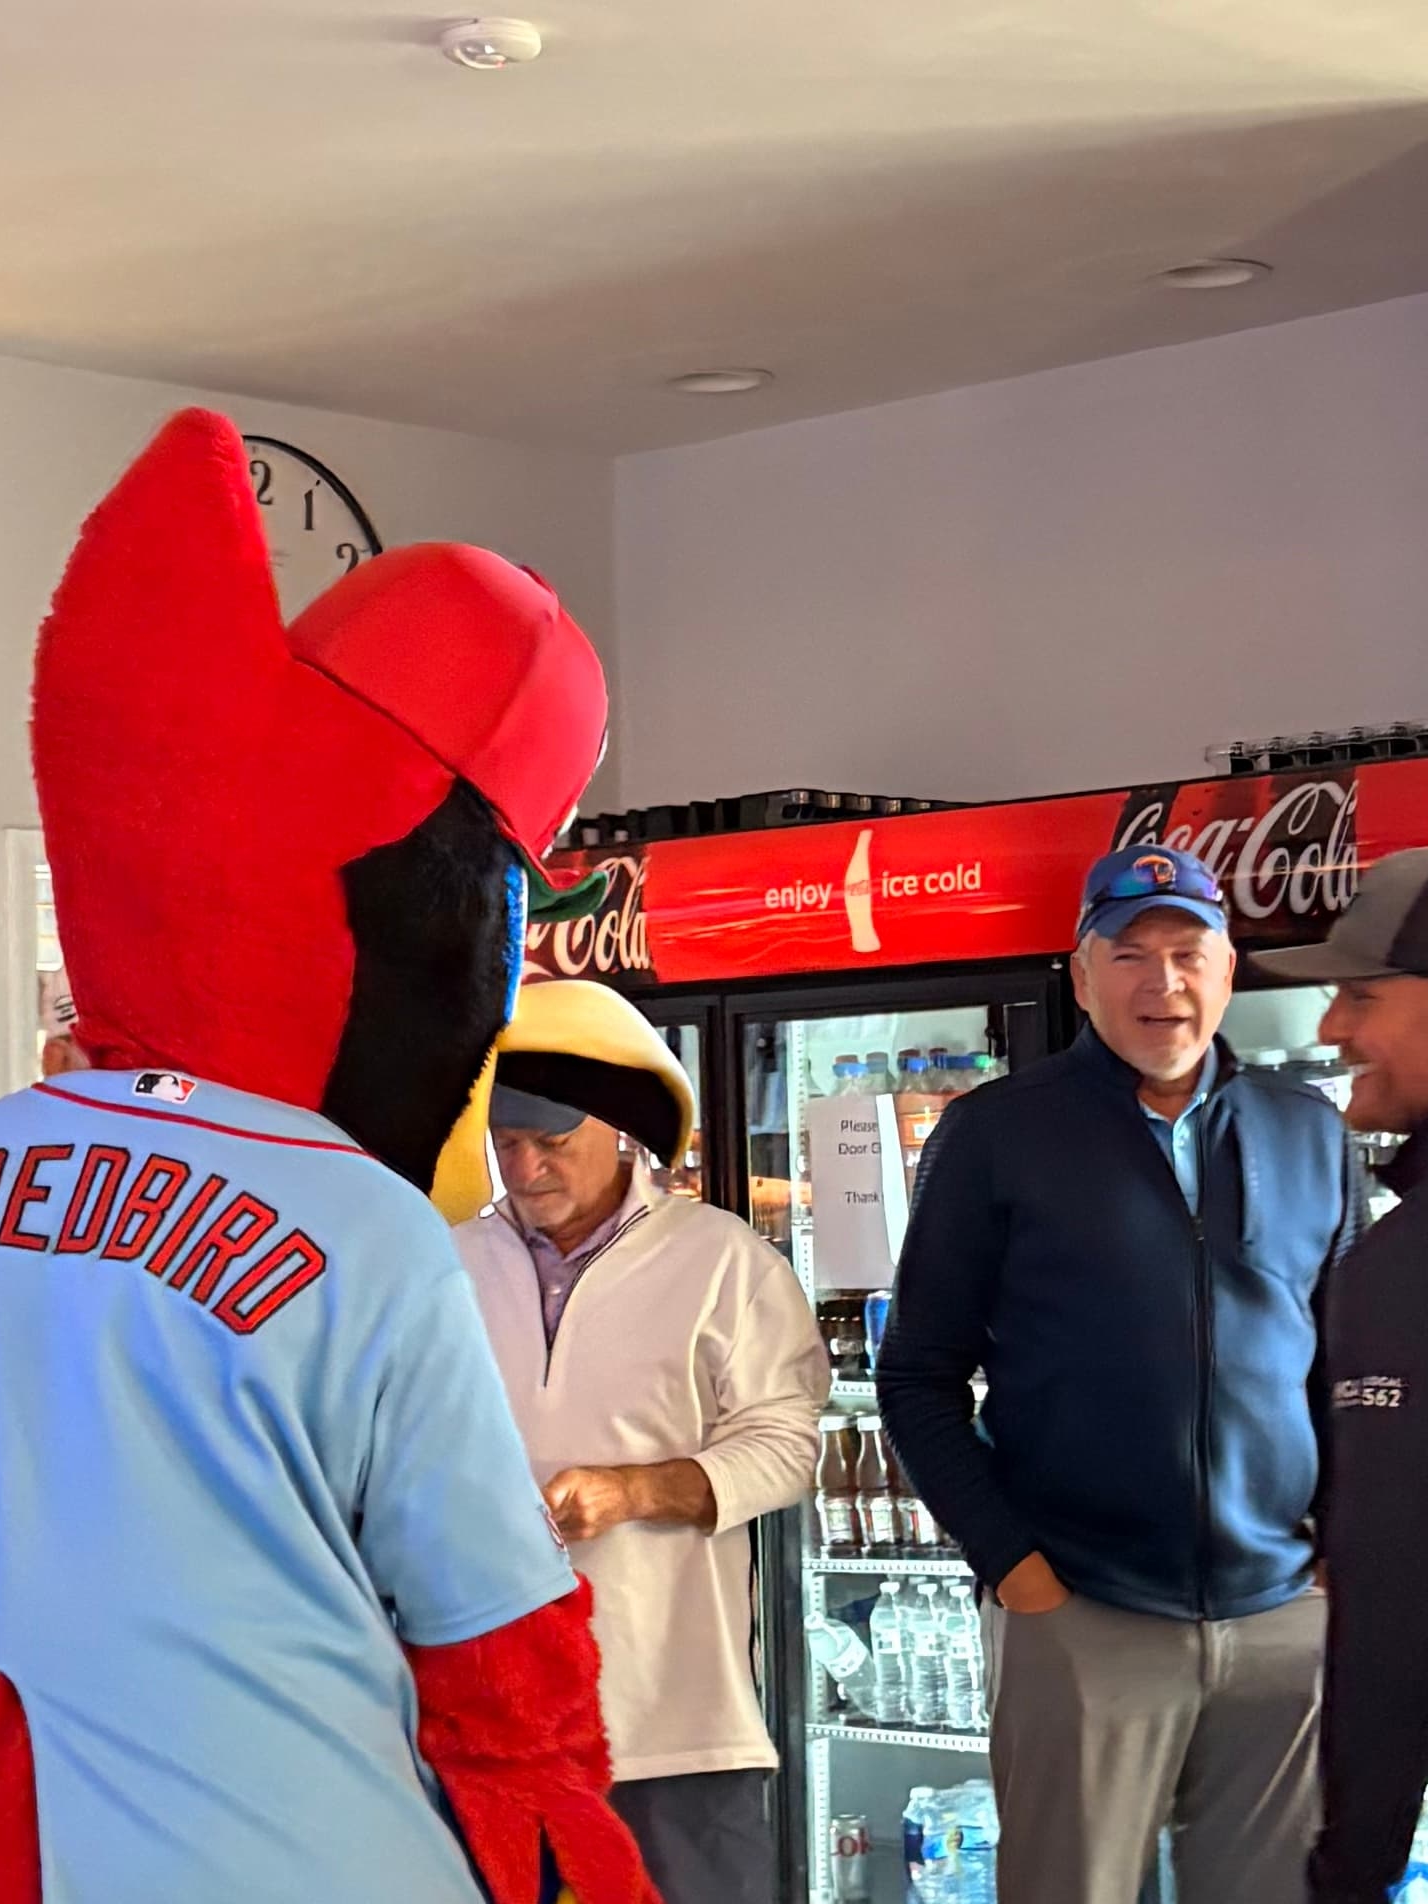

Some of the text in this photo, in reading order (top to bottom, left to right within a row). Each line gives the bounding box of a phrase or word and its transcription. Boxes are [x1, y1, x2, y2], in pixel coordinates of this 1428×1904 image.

[249, 460, 274, 506] 2
[303, 489, 315, 531] 1
[1116, 780, 1360, 919] a-Cola
[764, 880, 833, 912] enjoy
[881, 871, 919, 899] ice
[924, 861, 982, 895] cold
